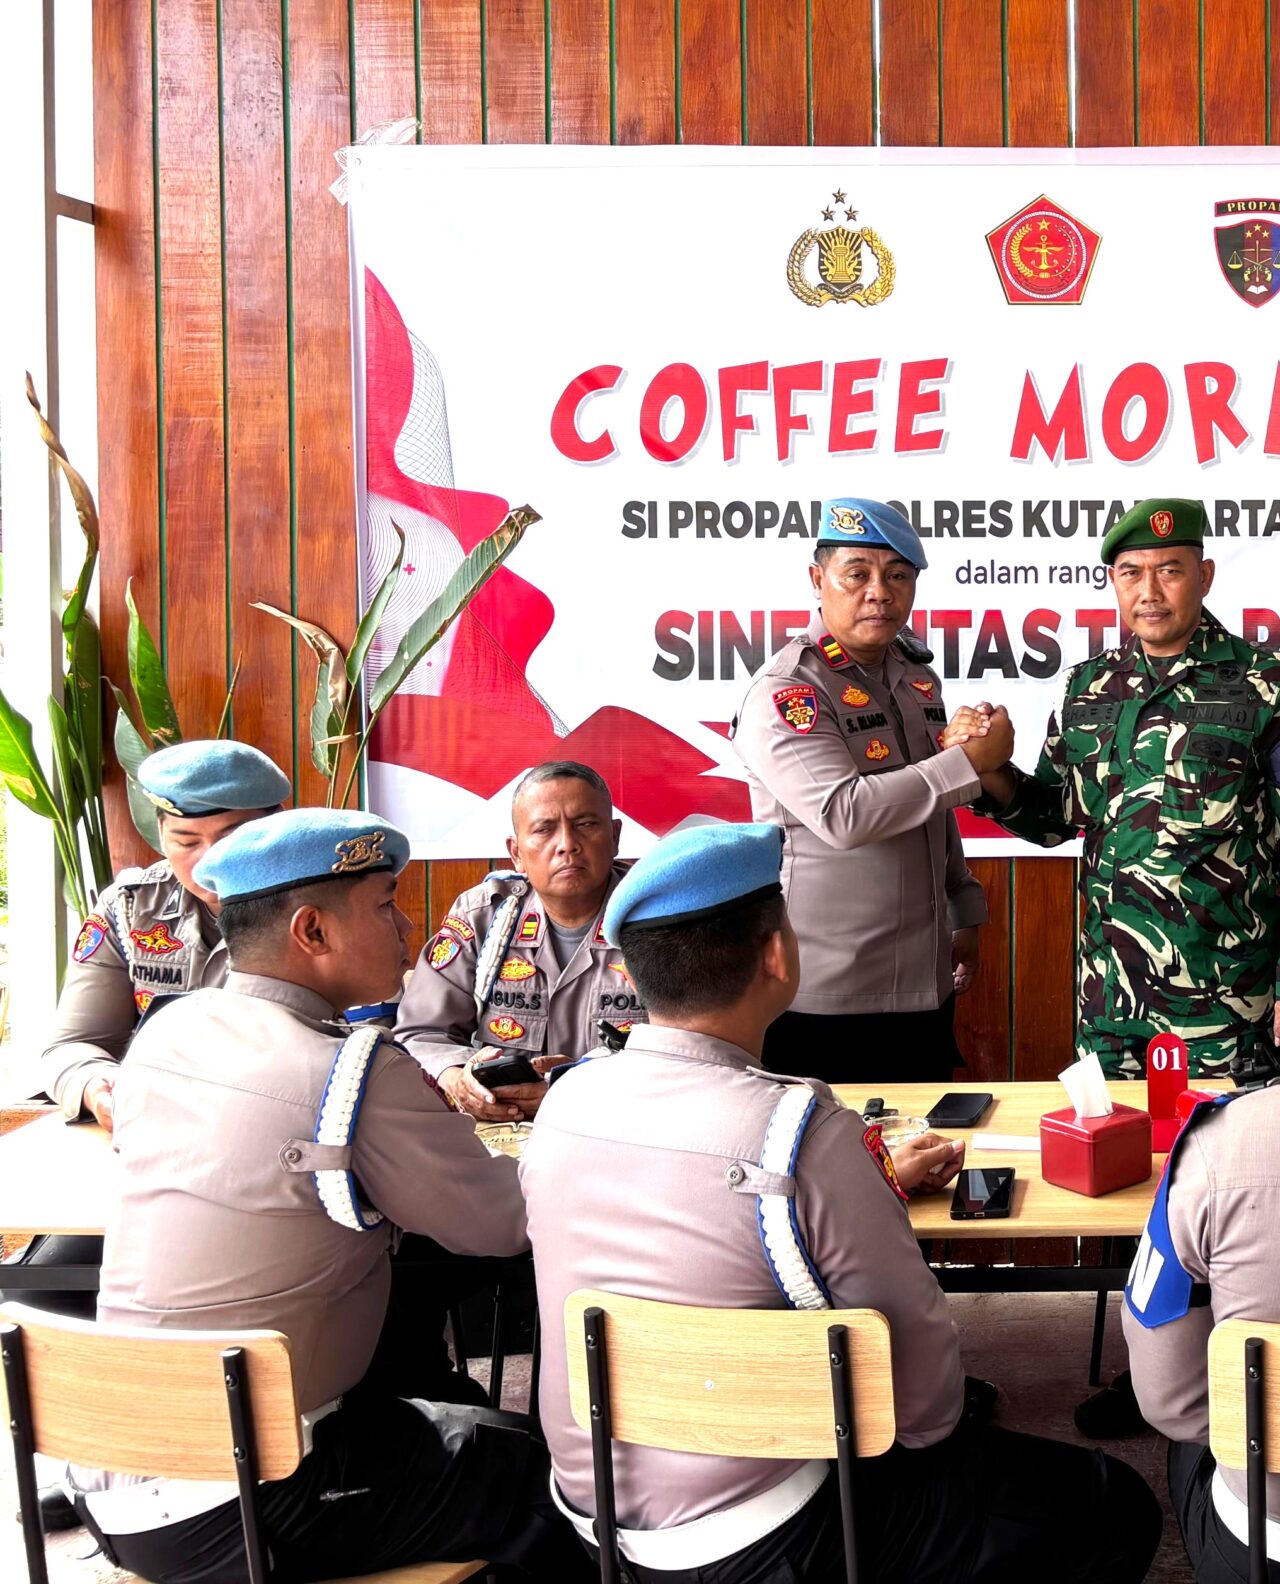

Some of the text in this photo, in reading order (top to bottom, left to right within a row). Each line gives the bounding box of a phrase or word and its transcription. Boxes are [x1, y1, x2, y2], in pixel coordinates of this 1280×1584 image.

[550, 357, 951, 466] COFFEE
[621, 500, 657, 539] SI
[669, 500, 822, 539] PROPA
[885, 500, 1013, 538] LRES
[1023, 499, 1144, 538] KUTA
[955, 559, 1108, 590] dalam rang
[652, 607, 1062, 681] SINEITAS
[777, 687, 810, 699] PROPAM
[133, 964, 182, 985] ATHAMA
[600, 993, 645, 1011] POL
[1152, 1046, 1182, 1071] 01
